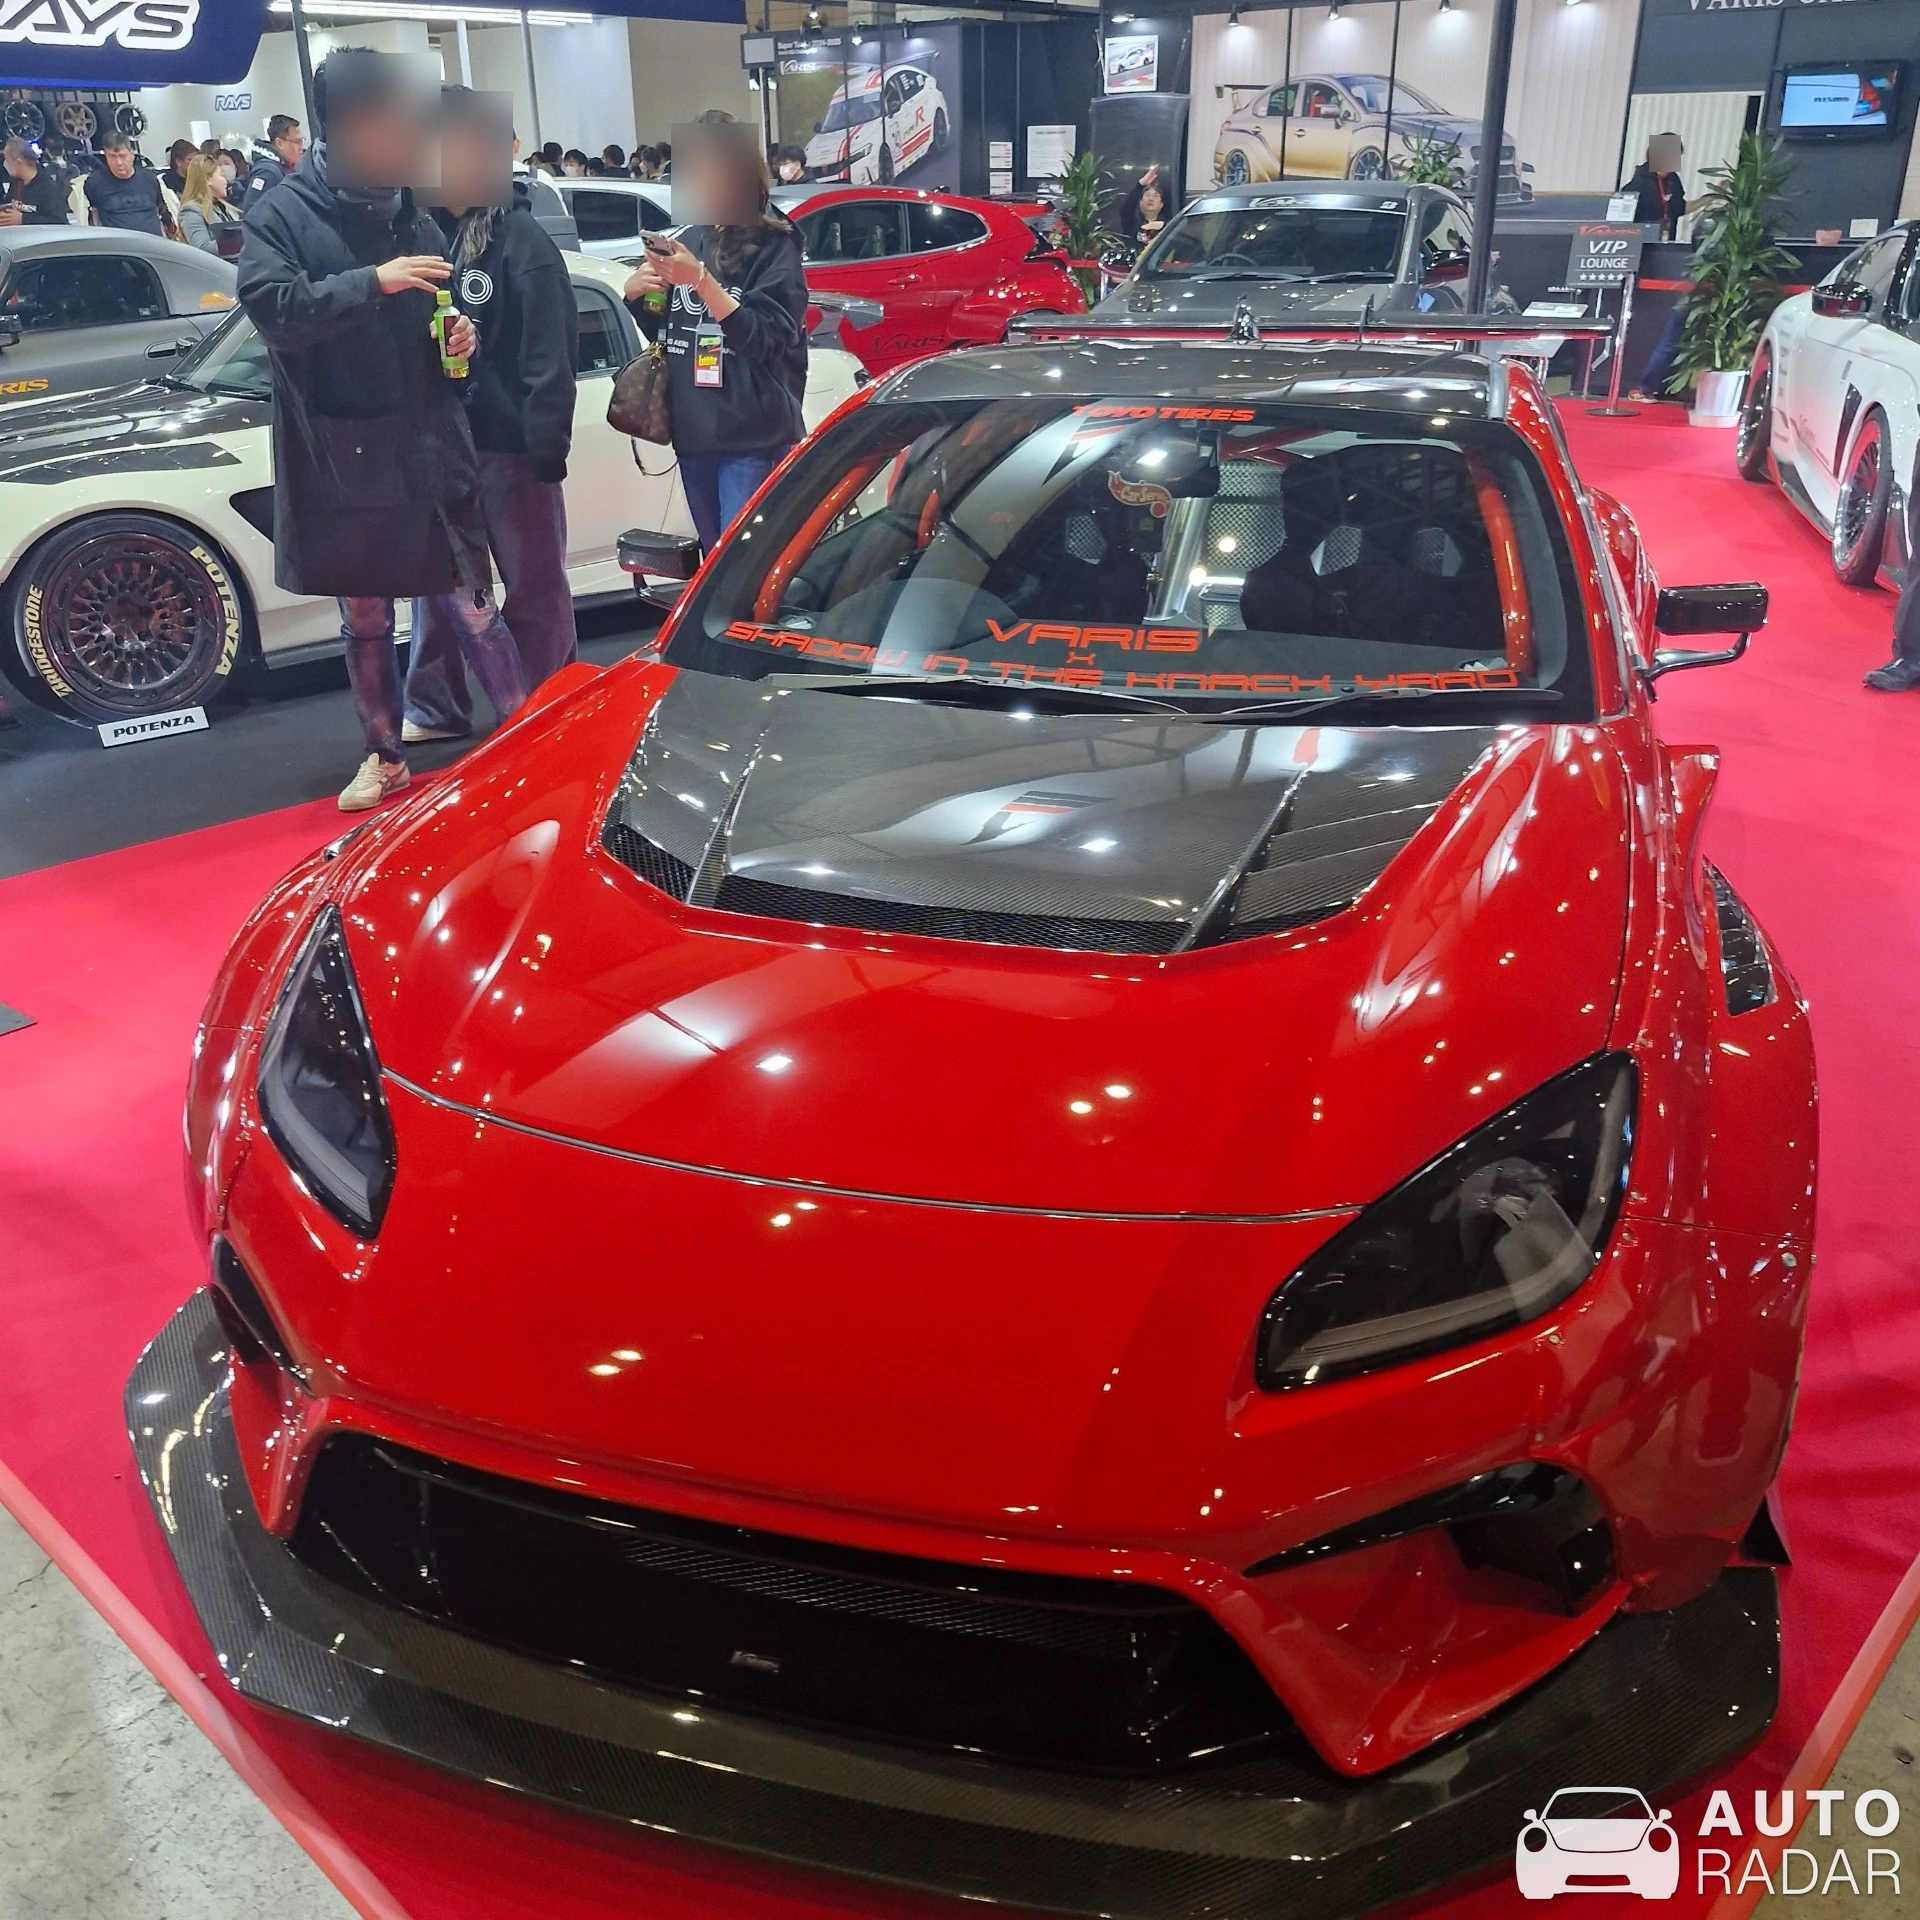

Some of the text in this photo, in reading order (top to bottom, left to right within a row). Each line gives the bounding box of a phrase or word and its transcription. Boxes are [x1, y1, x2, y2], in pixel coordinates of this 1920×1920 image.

[0, 0, 192, 40] AYS
[215, 94, 252, 111] RAYS
[1589, 240, 1628, 254] VIP
[1580, 258, 1629, 269] LOUNGE
[1072, 405, 1256, 422] TOYO TIRES
[190, 545, 240, 677] POTENZA
[25, 584, 74, 698] BRIDGESTONE
[986, 619, 1200, 652] VARIS
[723, 621, 908, 667] SHADOW
[990, 661, 1103, 687] THE
[1126, 671, 1331, 692] KNACK
[1354, 670, 1519, 691] YARD
[114, 715, 196, 738] POTENZA
